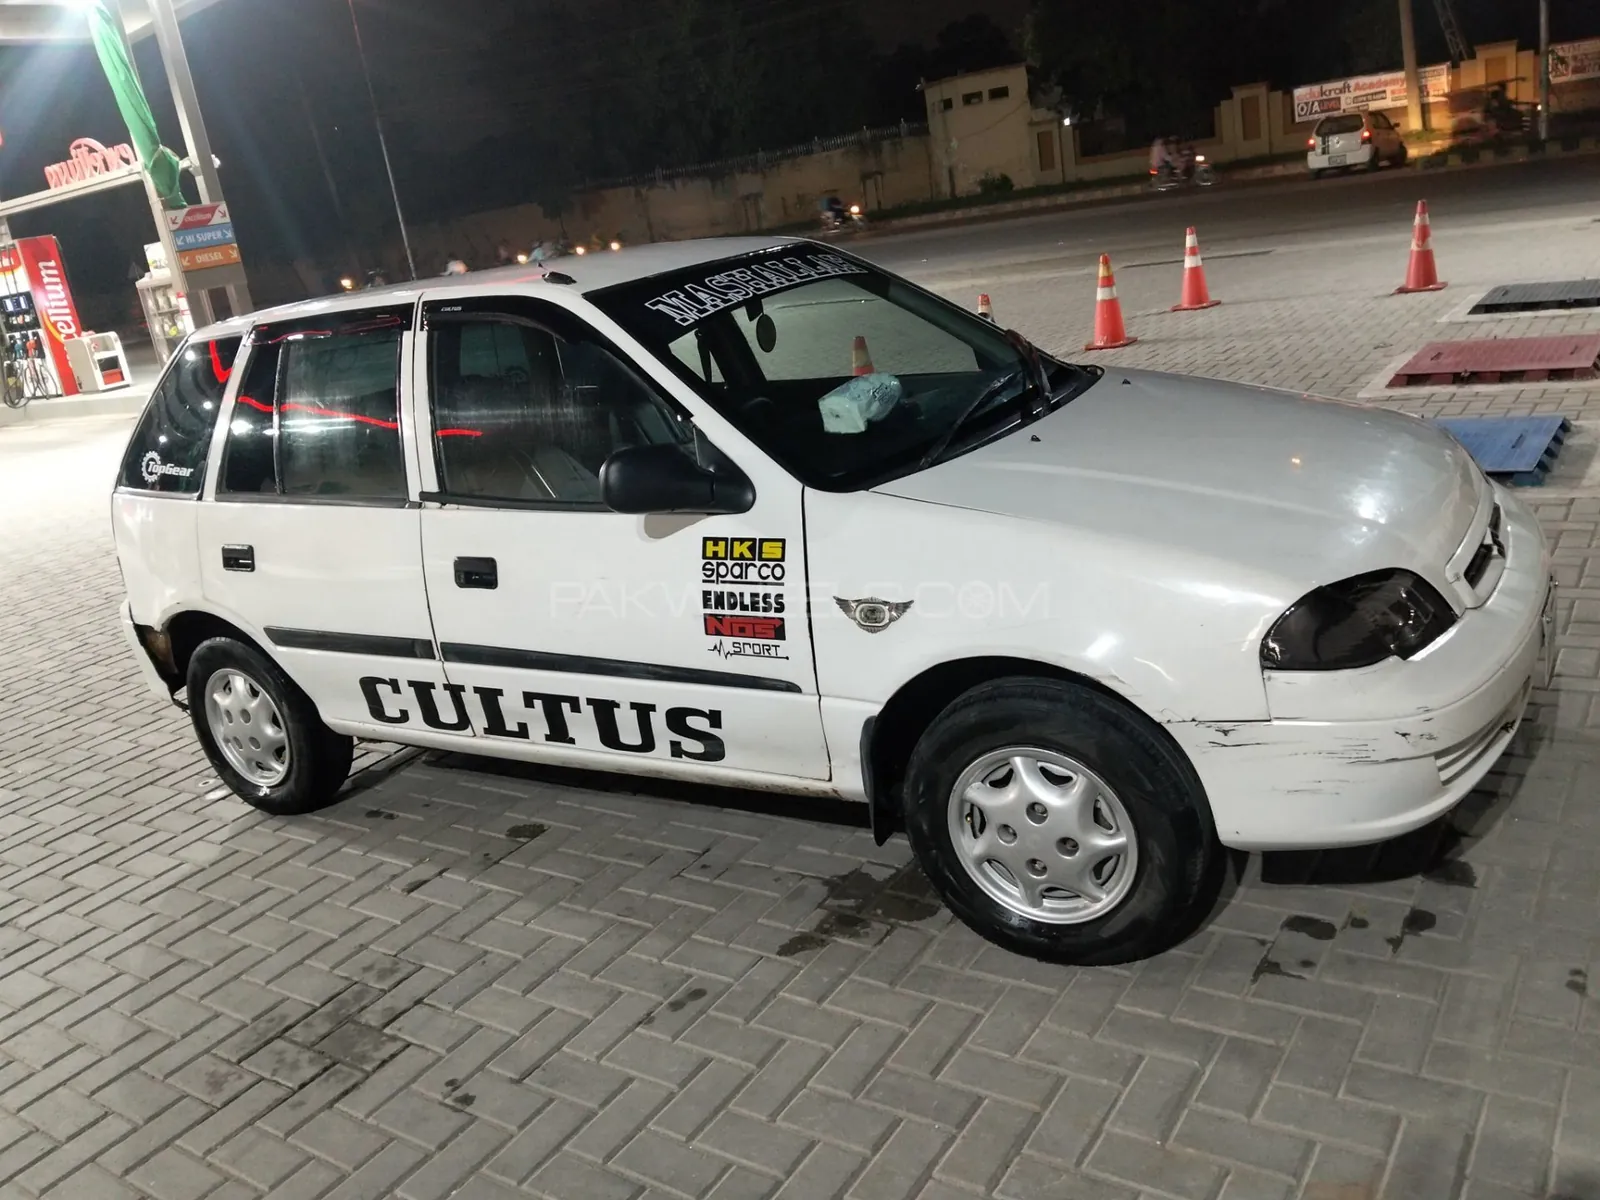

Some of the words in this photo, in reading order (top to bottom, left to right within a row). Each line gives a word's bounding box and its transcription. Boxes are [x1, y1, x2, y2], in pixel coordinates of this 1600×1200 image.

[1297, 100, 1320, 116] O/A
[185, 234, 195, 244] HI
[196, 229, 223, 242] SUPER
[195, 252, 223, 264] DIESEL
[37, 259, 78, 370] cellium
[704, 539, 784, 560] HKS
[702, 561, 786, 585] sparco
[702, 590, 785, 613] ENDLESS
[705, 615, 784, 639] NOS
[358, 676, 725, 762] CULTUS
